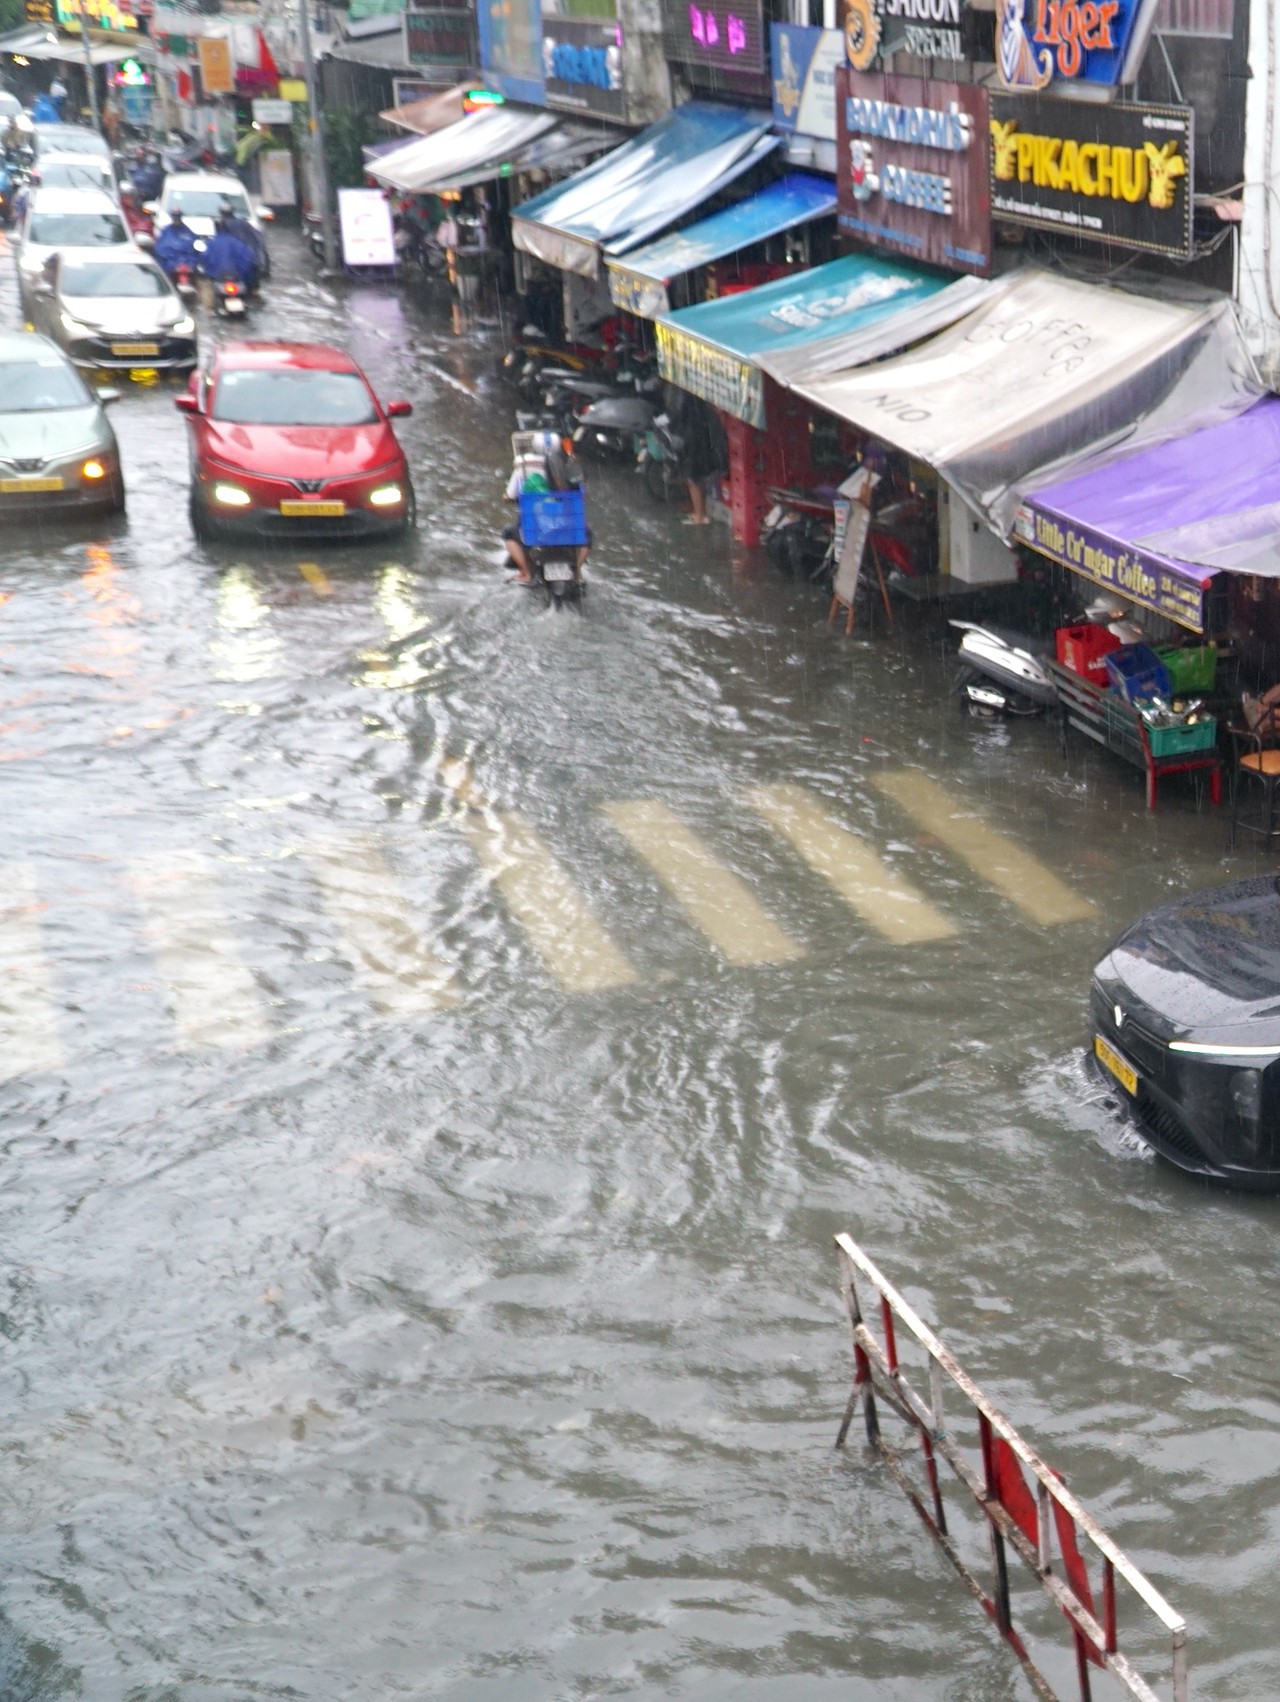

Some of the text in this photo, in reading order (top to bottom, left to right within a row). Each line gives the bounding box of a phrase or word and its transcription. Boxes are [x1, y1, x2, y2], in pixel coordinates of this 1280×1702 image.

[881, 164, 953, 216] COFFEE
[1017, 132, 1150, 203] PIKACHU
[1036, 514, 1065, 555] Little
[1117, 556, 1157, 600] Coffee
